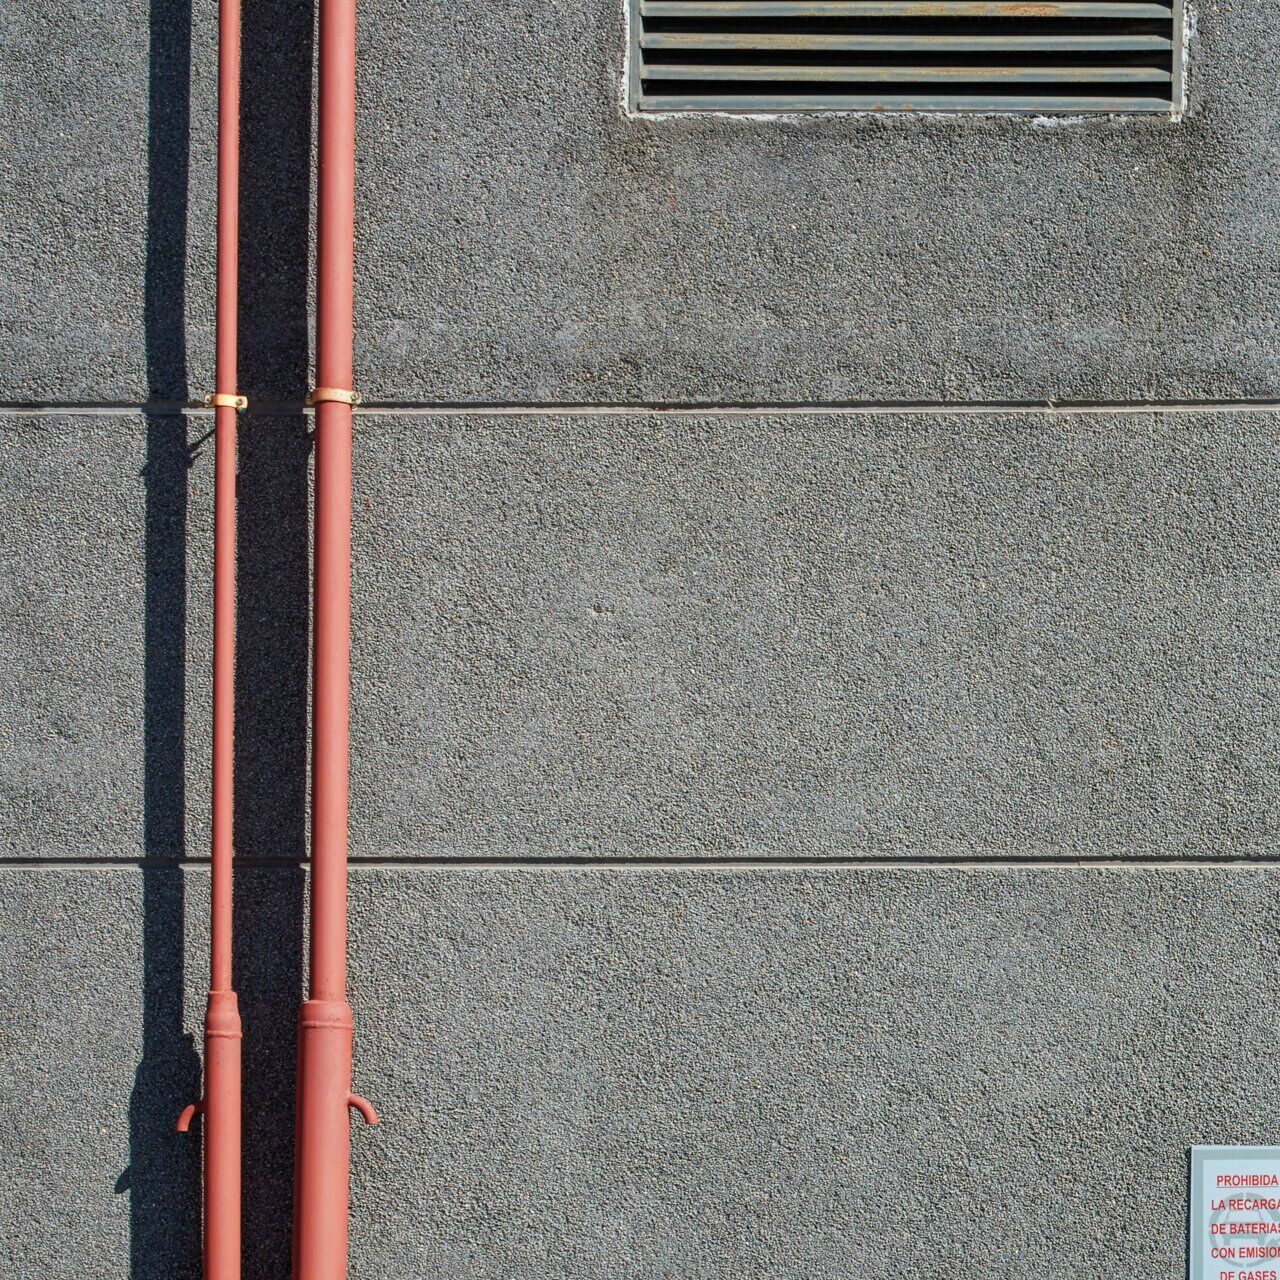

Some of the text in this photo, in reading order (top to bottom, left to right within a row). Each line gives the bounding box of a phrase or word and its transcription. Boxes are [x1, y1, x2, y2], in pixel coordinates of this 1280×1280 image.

[1217, 1175, 1279, 1187] PROHIBIDA
[1211, 1199, 1226, 1211] LA
[1211, 1223, 1226, 1235] DE
[1211, 1247, 1235, 1259] CON
